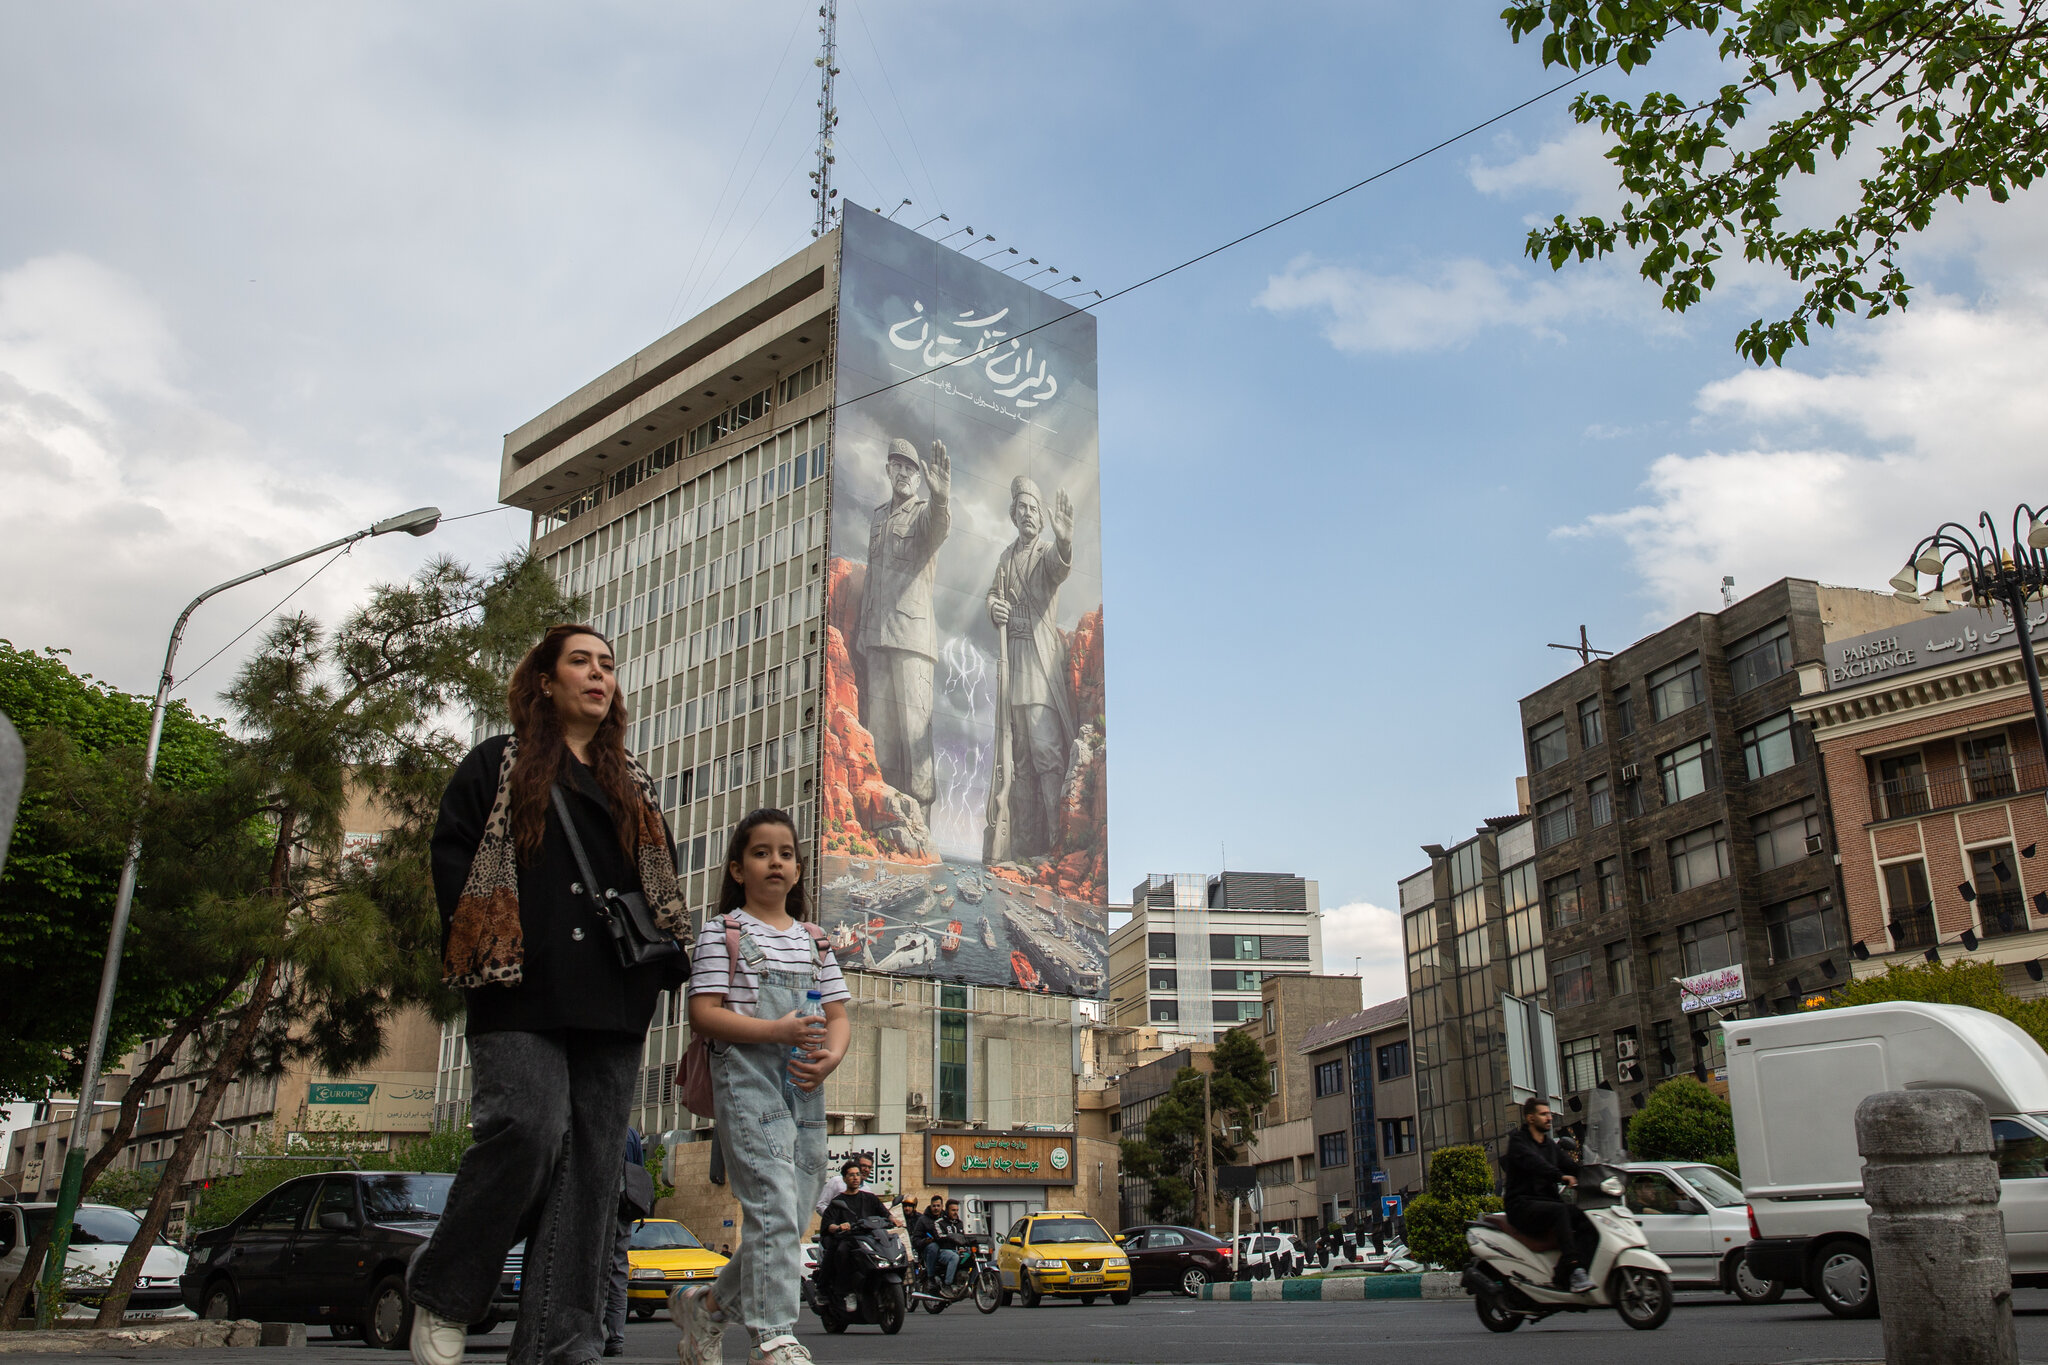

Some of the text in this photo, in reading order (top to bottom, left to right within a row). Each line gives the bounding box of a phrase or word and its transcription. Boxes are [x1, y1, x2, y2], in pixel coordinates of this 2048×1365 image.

[985, 338, 1058, 408] دلیران
[944, 381, 974, 400] تاریخ
[973, 395, 1000, 412] دلیران
[1925, 625, 1978, 653] پارسه
[1831, 649, 1916, 682] EXCHANGE
[1011, 1140, 1028, 1150] وزارت
[961, 1154, 992, 1173] استقلال
[994, 1155, 1013, 1173] جهاد
[1014, 1160, 1040, 1173] موسسه
